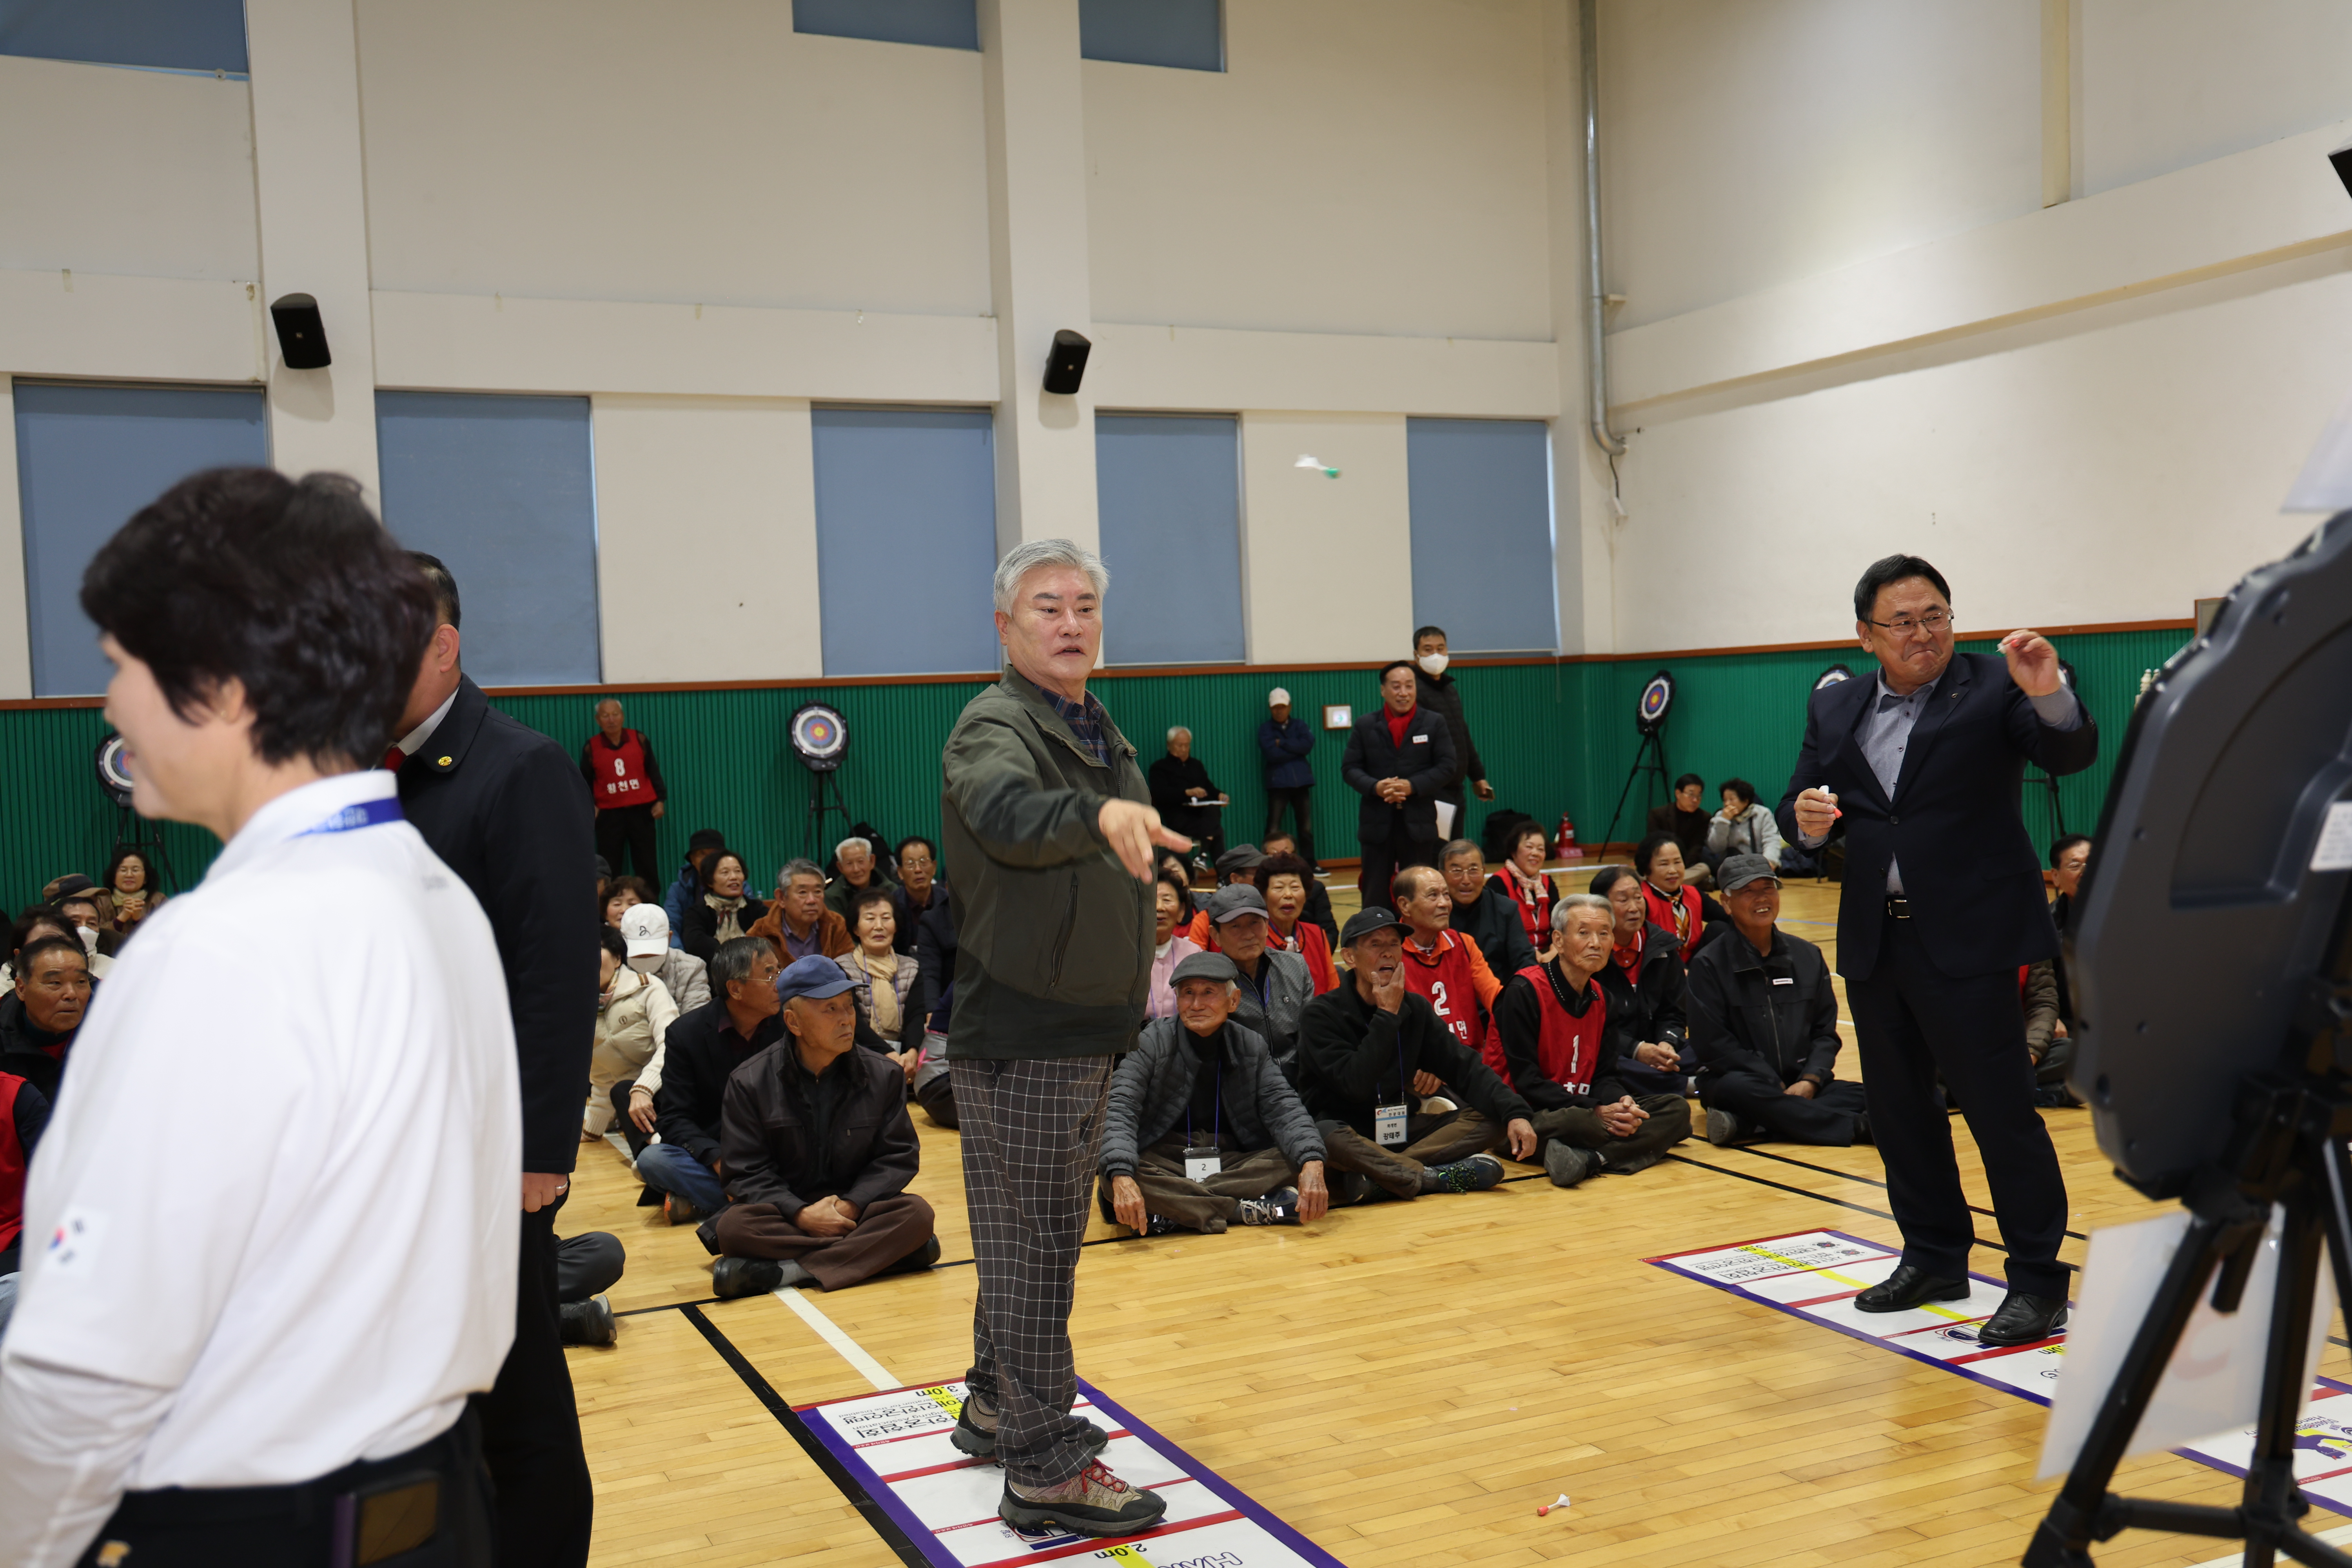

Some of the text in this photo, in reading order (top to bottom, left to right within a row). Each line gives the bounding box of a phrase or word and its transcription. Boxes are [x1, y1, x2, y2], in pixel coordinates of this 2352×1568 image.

[614, 758, 626, 777] 8
[1432, 981, 1450, 1016] 2
[1448, 1020, 1468, 1039] 면
[1570, 1035, 1579, 1074] 1
[915, 1385, 958, 1398] 3.0m
[903, 1397, 944, 1406] Federation
[852, 1409, 956, 1430] Hangung Association
[1093, 1543, 1148, 1560] 2.0m
